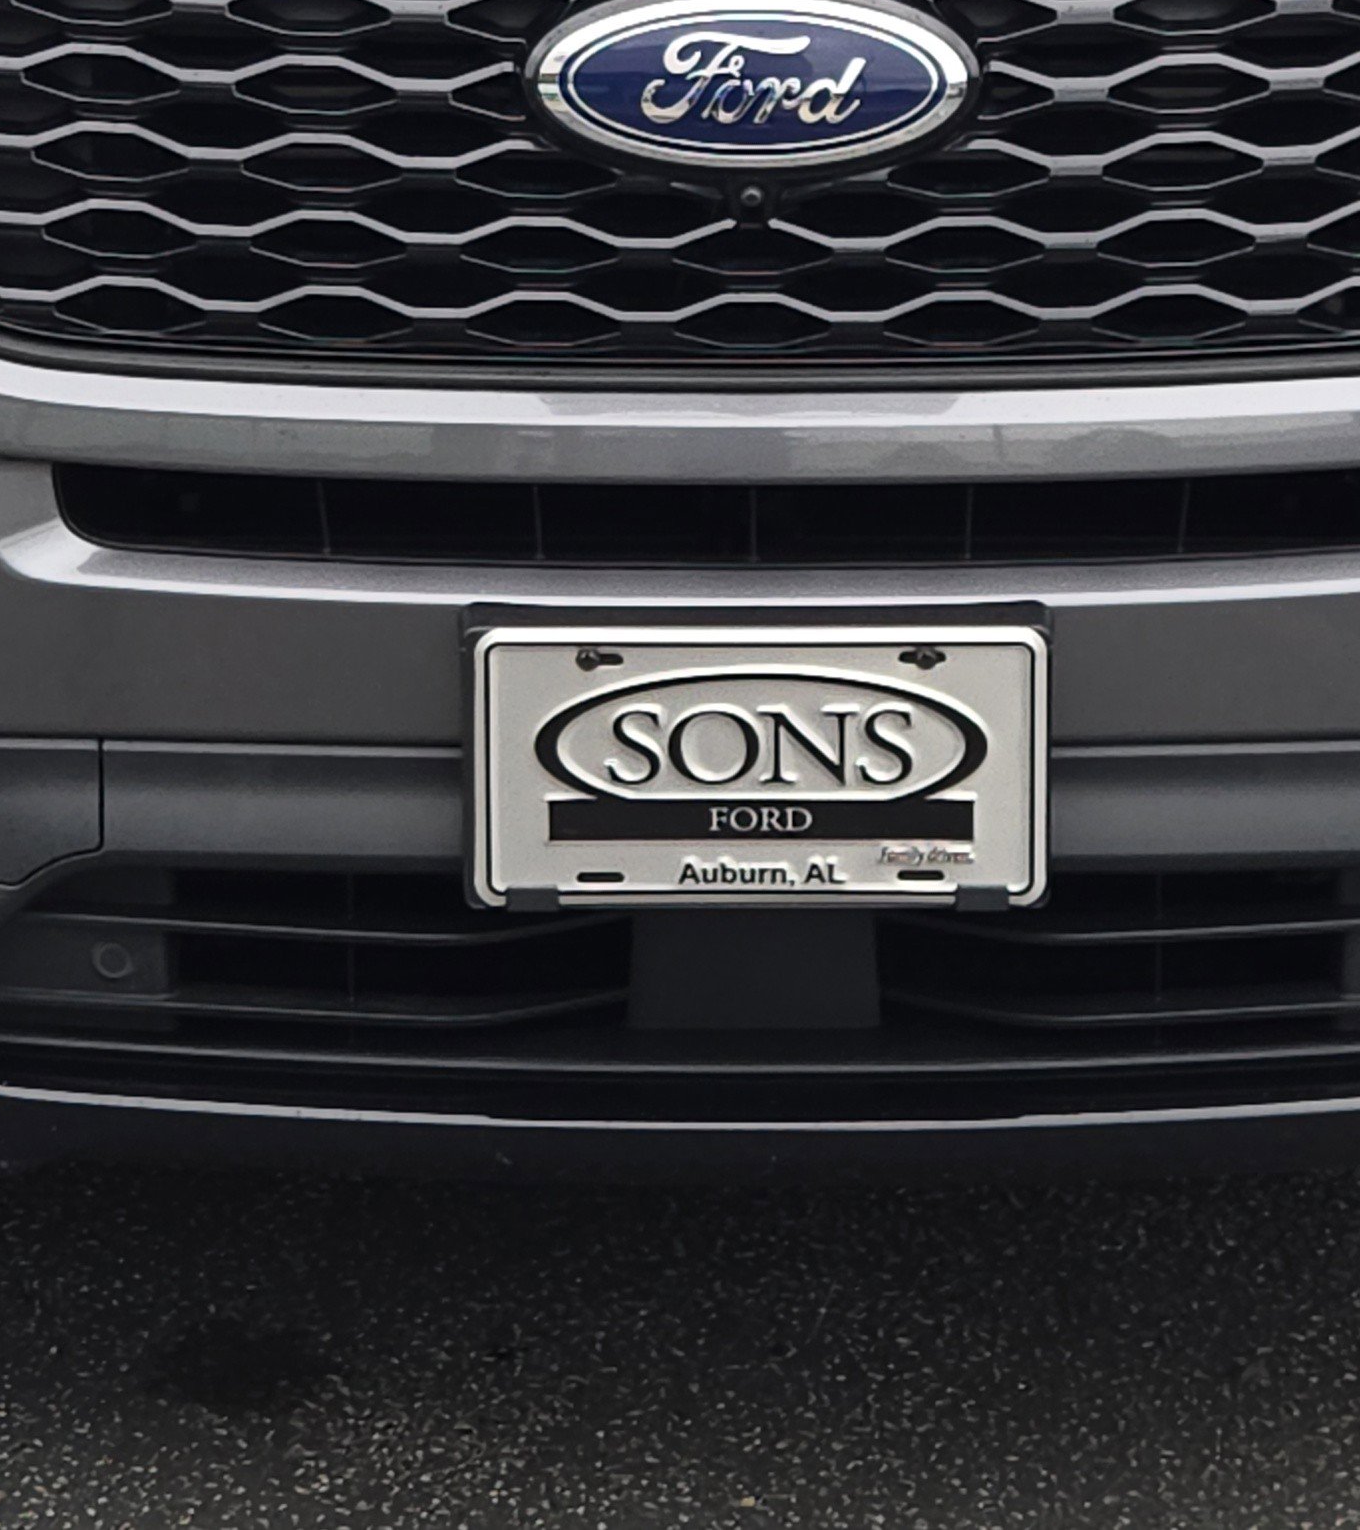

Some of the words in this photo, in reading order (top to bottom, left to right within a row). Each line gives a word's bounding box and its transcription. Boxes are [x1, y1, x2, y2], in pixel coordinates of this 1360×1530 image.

[642, 31, 867, 124] Ford
[604, 706, 915, 786] SONS
[708, 806, 813, 832] FORD
[678, 862, 796, 887] Auburn,
[804, 862, 846, 885] AL
